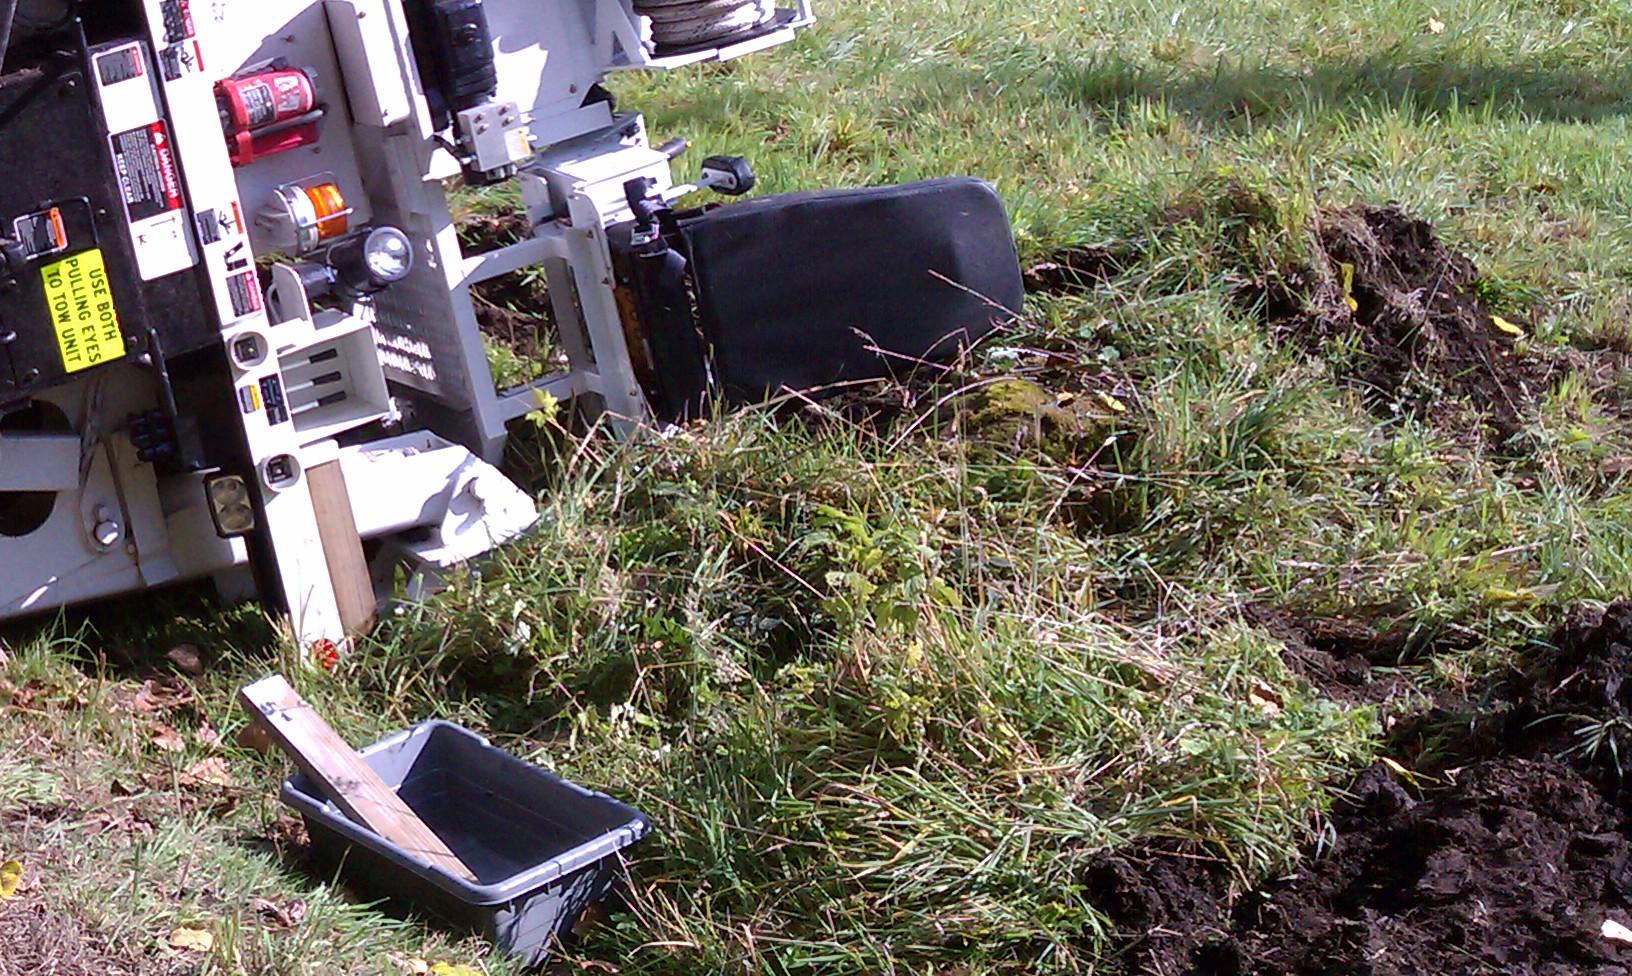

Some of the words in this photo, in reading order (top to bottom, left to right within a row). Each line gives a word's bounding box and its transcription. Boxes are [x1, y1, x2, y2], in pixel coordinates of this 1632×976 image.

[115, 153, 128, 175] KEEP
[159, 148, 179, 198] DANGER
[121, 176, 134, 204] CLEAR
[47, 268, 63, 289] TO
[88, 267, 107, 298] USE
[53, 292, 72, 324] TOW
[65, 258, 91, 321] PULLING
[81, 325, 102, 363] EYES
[96, 301, 118, 342] BOTH
[61, 327, 81, 362] UNIT
